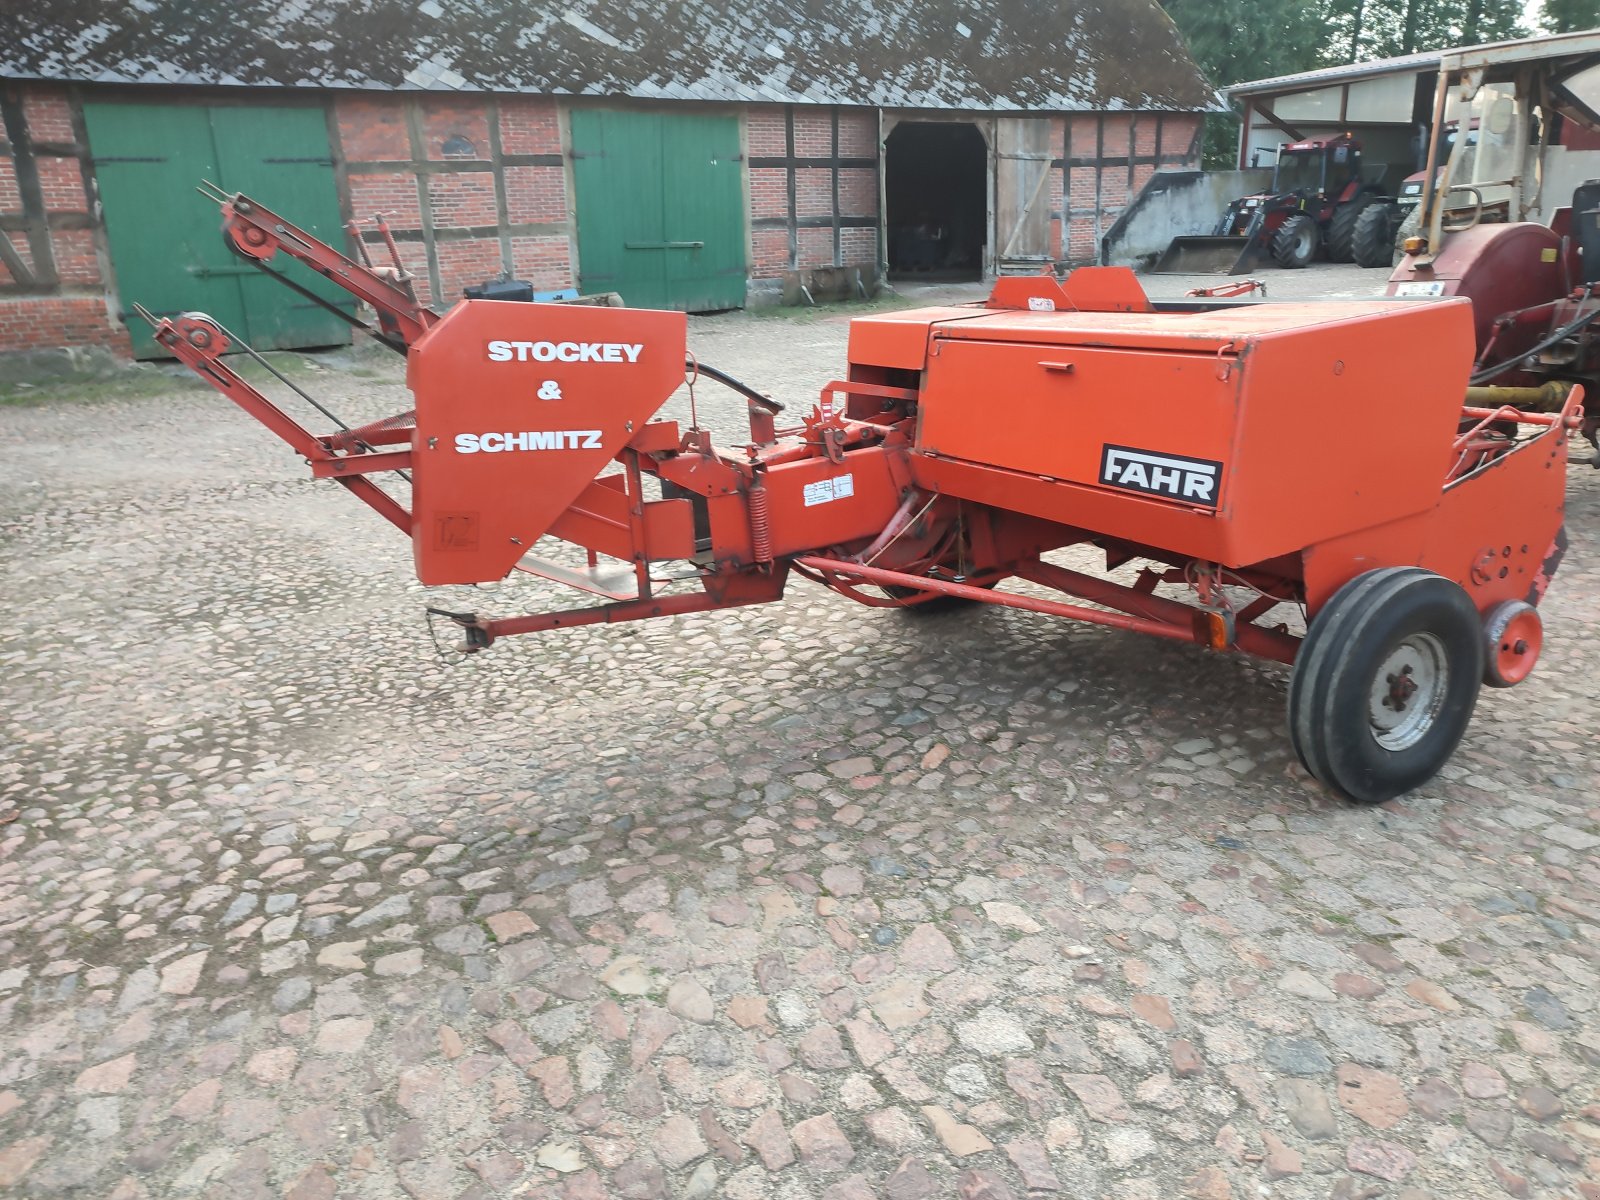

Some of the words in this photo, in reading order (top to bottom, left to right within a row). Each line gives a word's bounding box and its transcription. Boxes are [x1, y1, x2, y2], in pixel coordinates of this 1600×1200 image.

[487, 340, 643, 363] STOCKEY
[536, 380, 562, 400] &
[454, 430, 602, 453] SCHMITZ
[1104, 448, 1216, 500] FAHR
